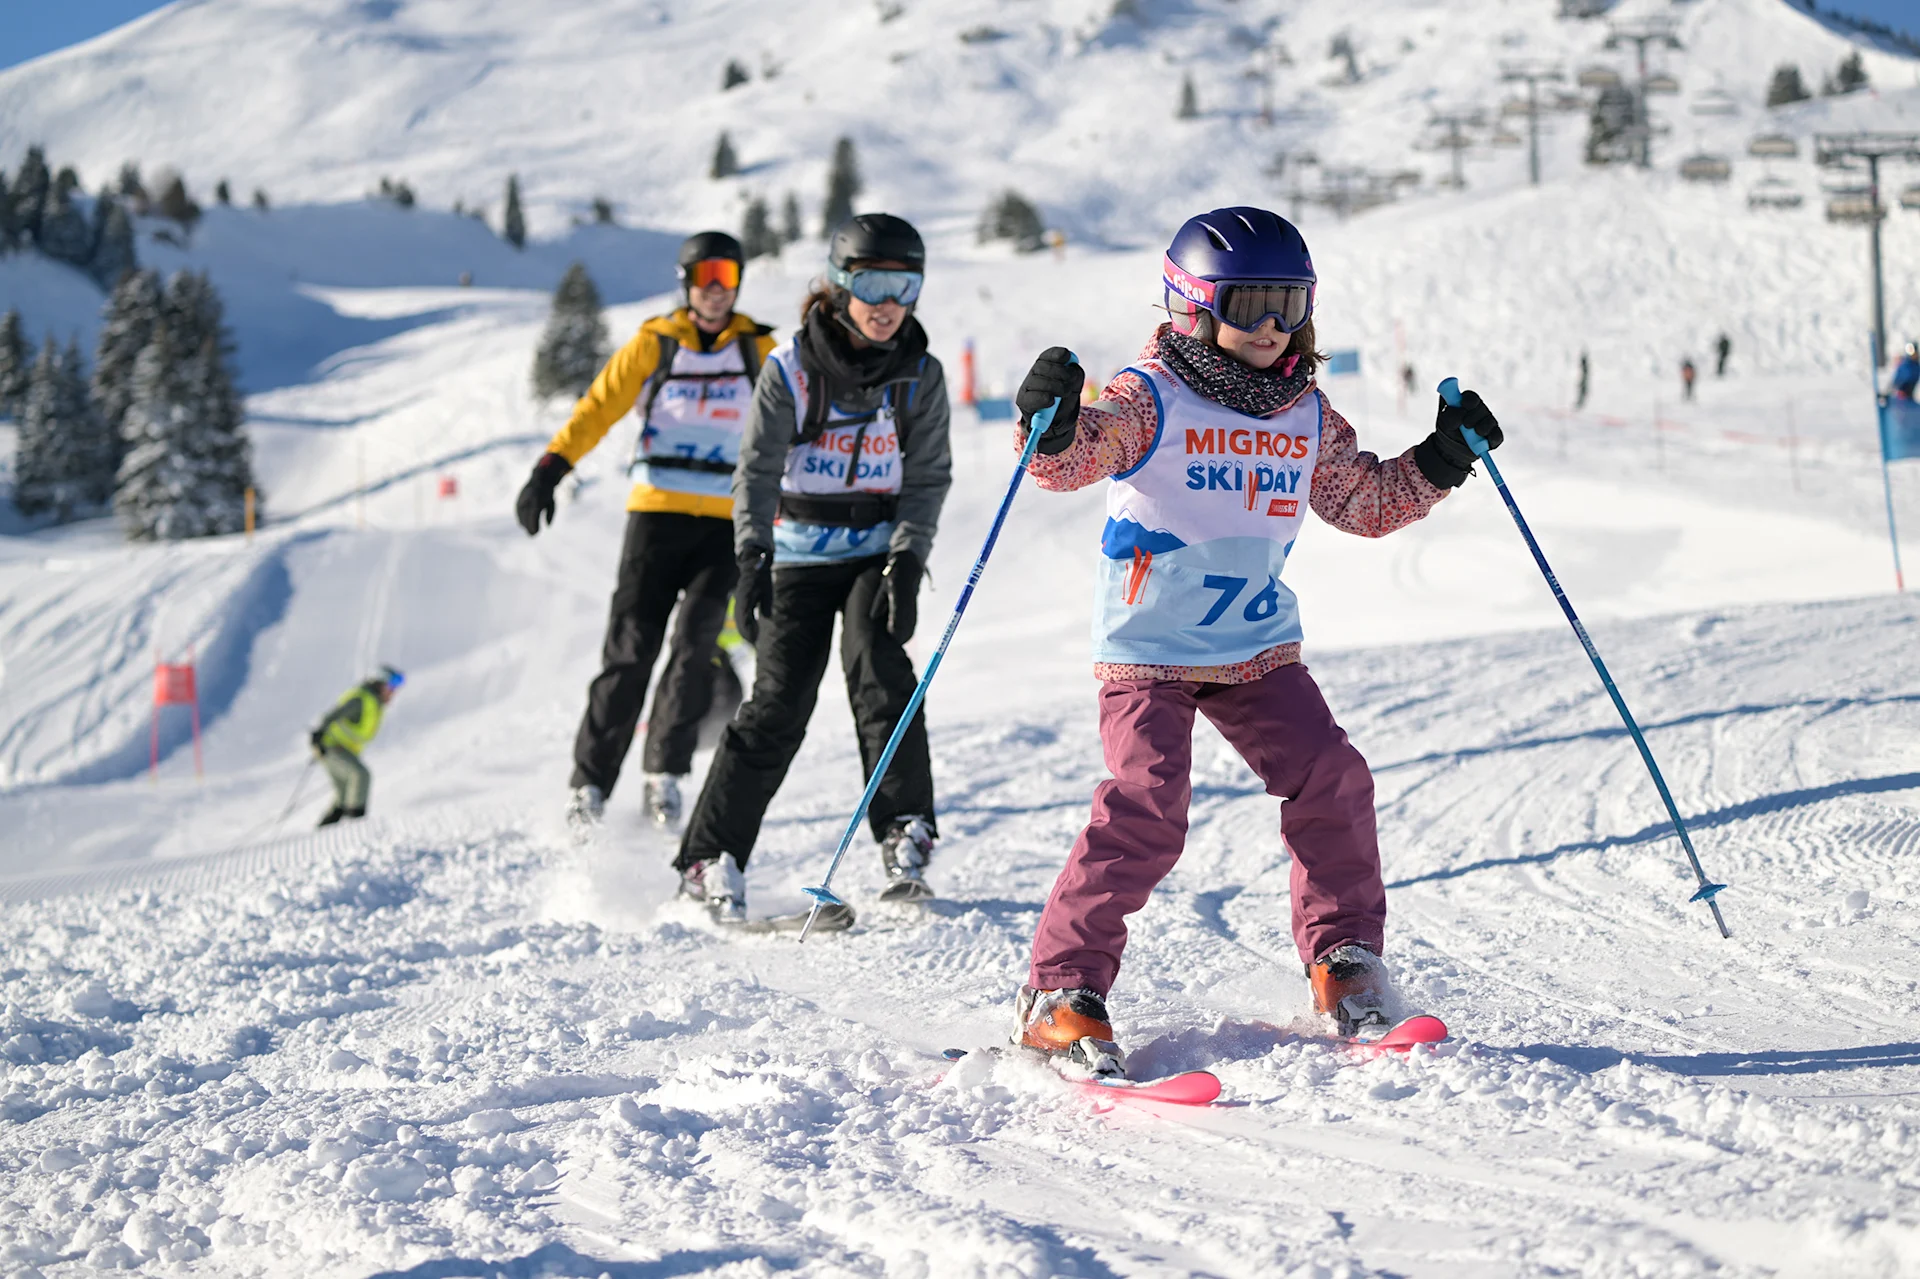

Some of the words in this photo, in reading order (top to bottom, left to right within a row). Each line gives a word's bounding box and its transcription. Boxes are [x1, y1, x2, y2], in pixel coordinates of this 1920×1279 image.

[811, 432, 897, 455] MIGROS
[1185, 428, 1309, 460] MIGROS
[803, 456, 846, 479] SKI
[855, 459, 894, 480] DAY
[1185, 460, 1244, 492] SKI
[1254, 460, 1302, 494] DAY
[1195, 574, 1280, 627] 76
